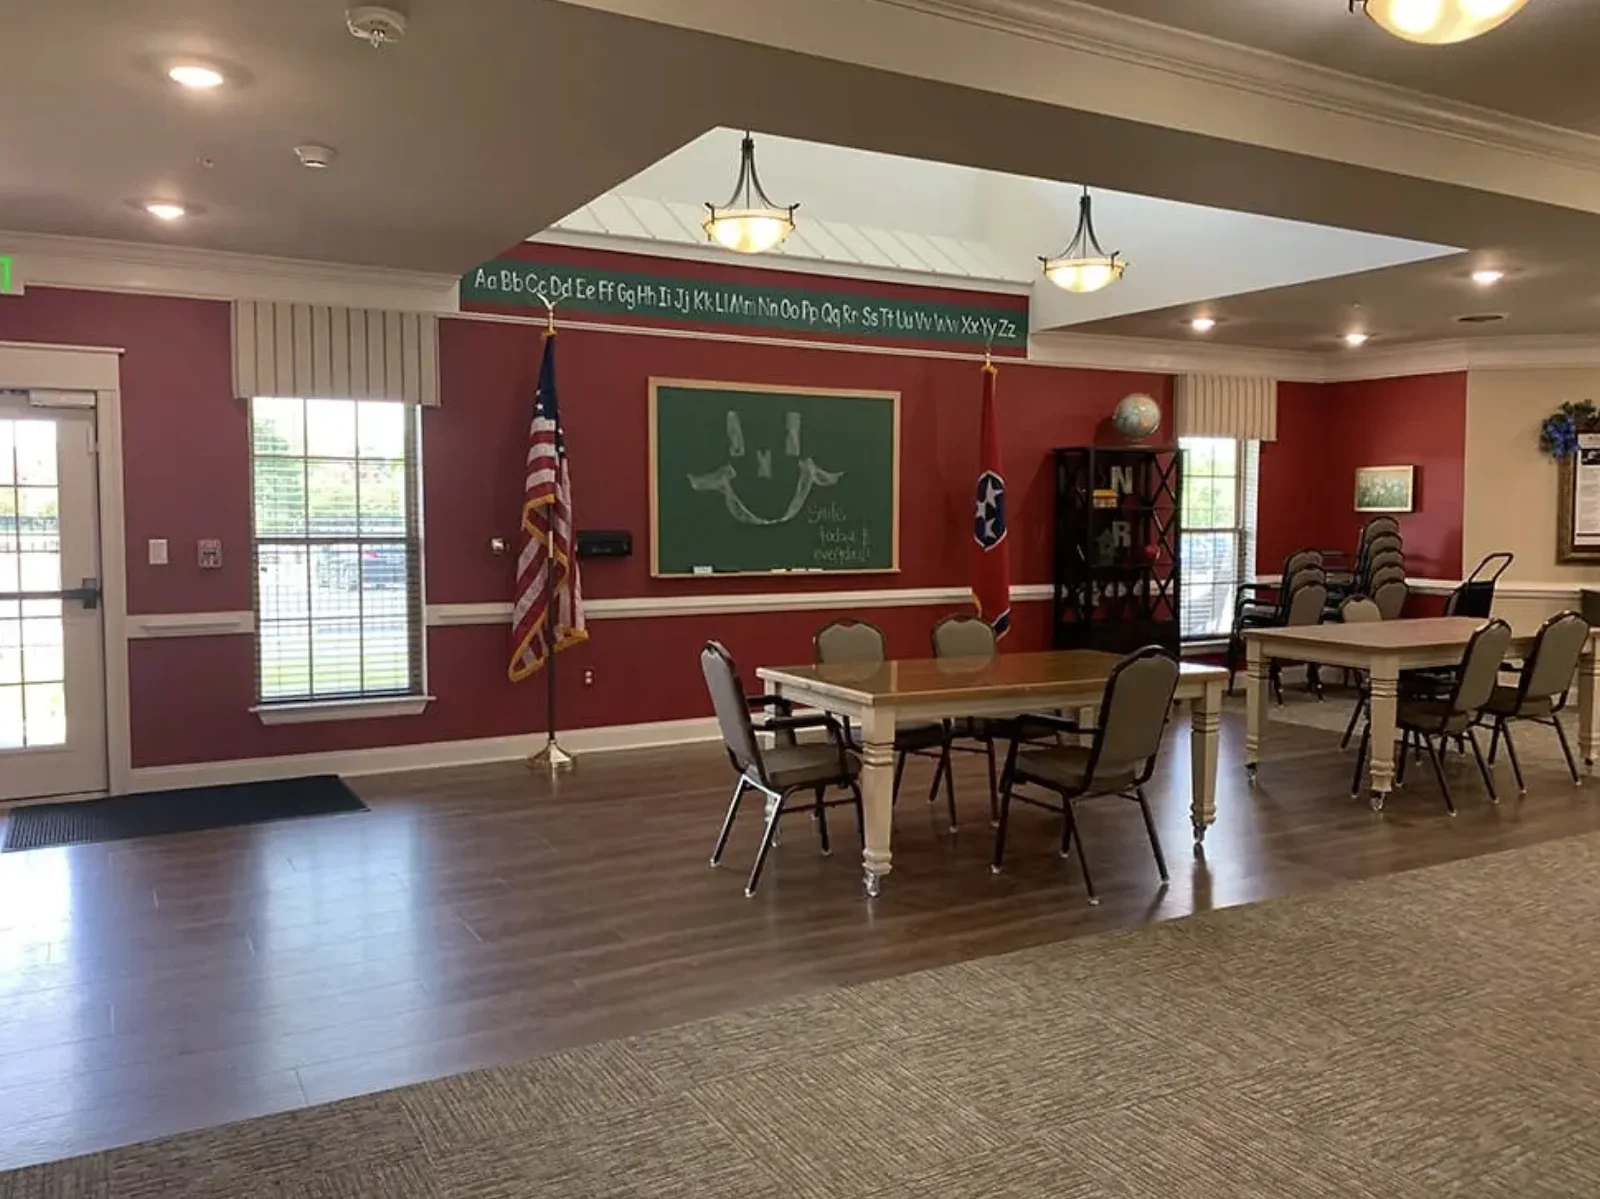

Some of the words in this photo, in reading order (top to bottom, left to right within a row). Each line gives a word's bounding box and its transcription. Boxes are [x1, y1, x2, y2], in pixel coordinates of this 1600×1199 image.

[474, 268, 498, 290] Aa
[500, 269, 523, 292] Bb
[525, 273, 547, 295] Cc
[550, 274, 572, 296] Dd
[575, 278, 596, 299] Ee
[598, 280, 615, 301] Ff
[617, 283, 635, 310] Gg
[637, 285, 657, 306] Hh
[658, 286, 671, 307] Ii
[674, 287, 690, 314] Jj
[693, 288, 714, 312] Kk
[758, 295, 779, 317] Nn
[780, 298, 800, 319] Oo
[801, 300, 819, 326] Pp
[821, 303, 841, 328] Qq
[842, 304, 859, 324] Rr
[862, 306, 879, 327] Ss
[879, 307, 895, 328] Tt
[896, 309, 914, 330] Uu
[914, 311, 932, 331] Vv
[961, 315, 980, 334] Xx
[998, 318, 1017, 338] Zz
